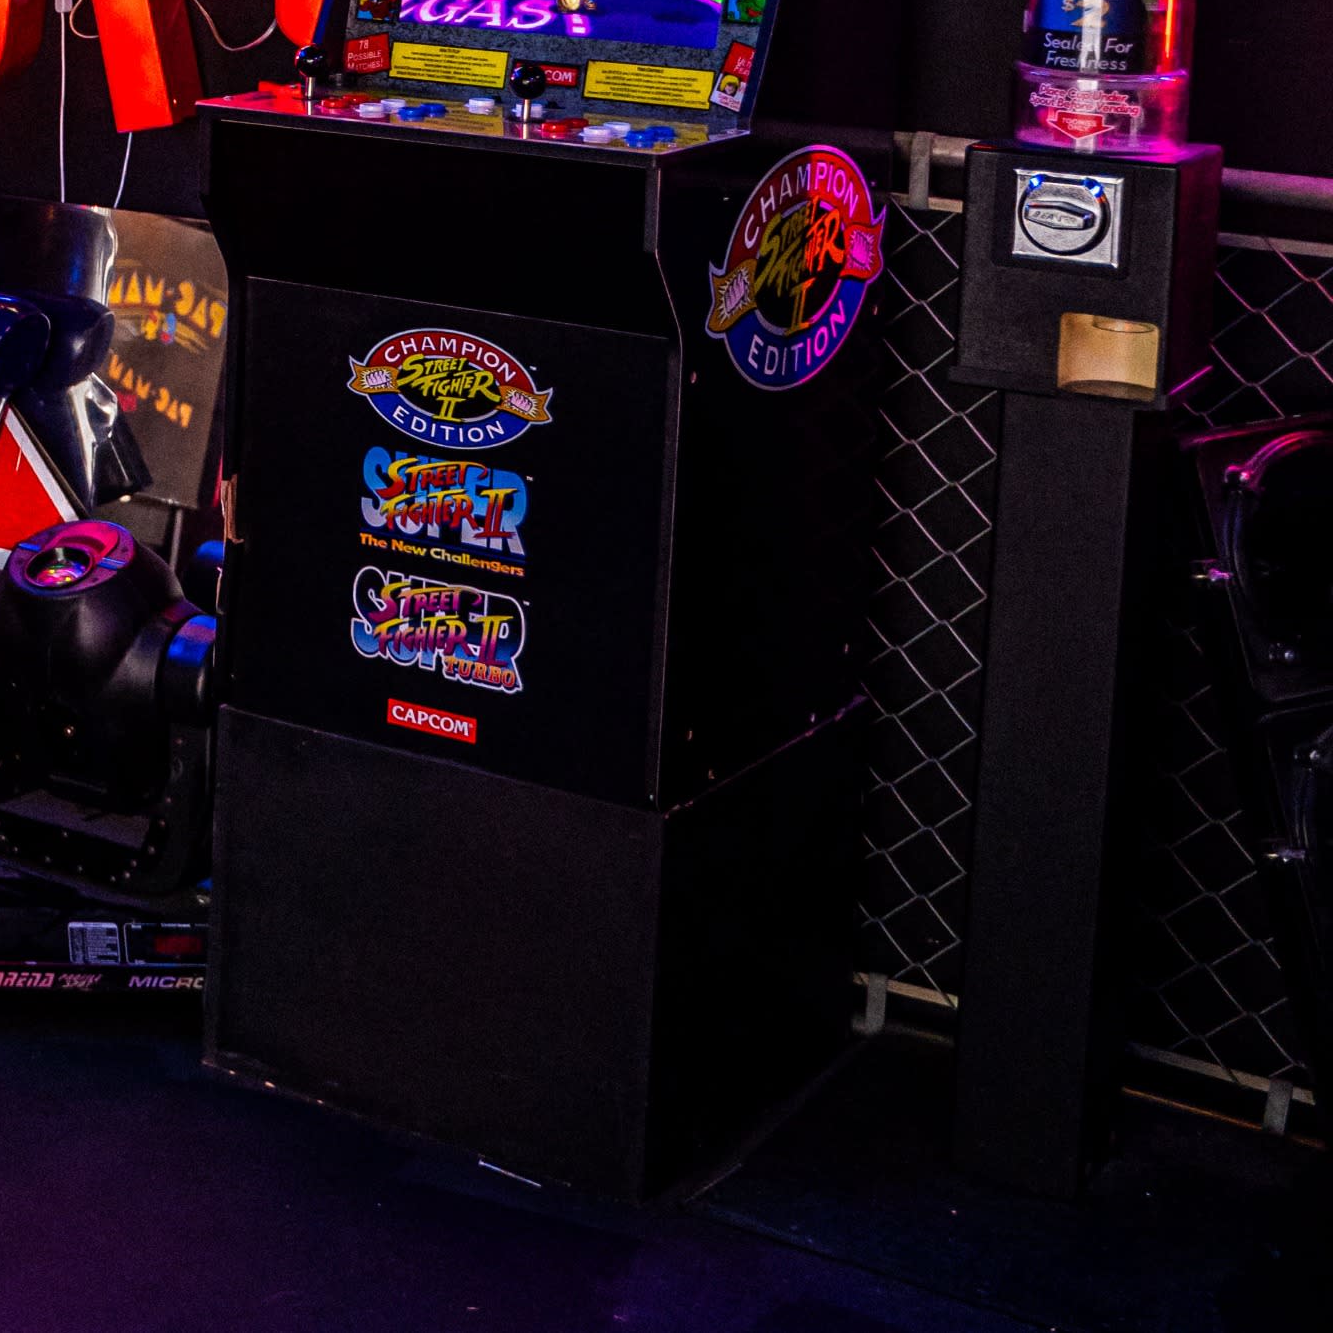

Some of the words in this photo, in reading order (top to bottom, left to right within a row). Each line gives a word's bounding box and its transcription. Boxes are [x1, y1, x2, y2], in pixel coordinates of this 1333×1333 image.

[1104, 37, 1133, 54] For
[743, 161, 860, 250] CHAMPION
[747, 297, 846, 377] EDITION
[384, 335, 517, 382] CHAMPION
[419, 369, 502, 404] FIGHTER
[393, 405, 505, 443] EDITION
[436, 396, 467, 423] II
[379, 457, 487, 499] STREET
[381, 488, 481, 531] FIGHTER
[359, 531, 388, 550] The
[391, 538, 427, 559] New
[429, 546, 525, 578] Challengers
[369, 582, 482, 622] STREET
[372, 614, 475, 657] FIGHTER
[445, 655, 517, 689] TURBO
[391, 705, 473, 738] CAPCOM
